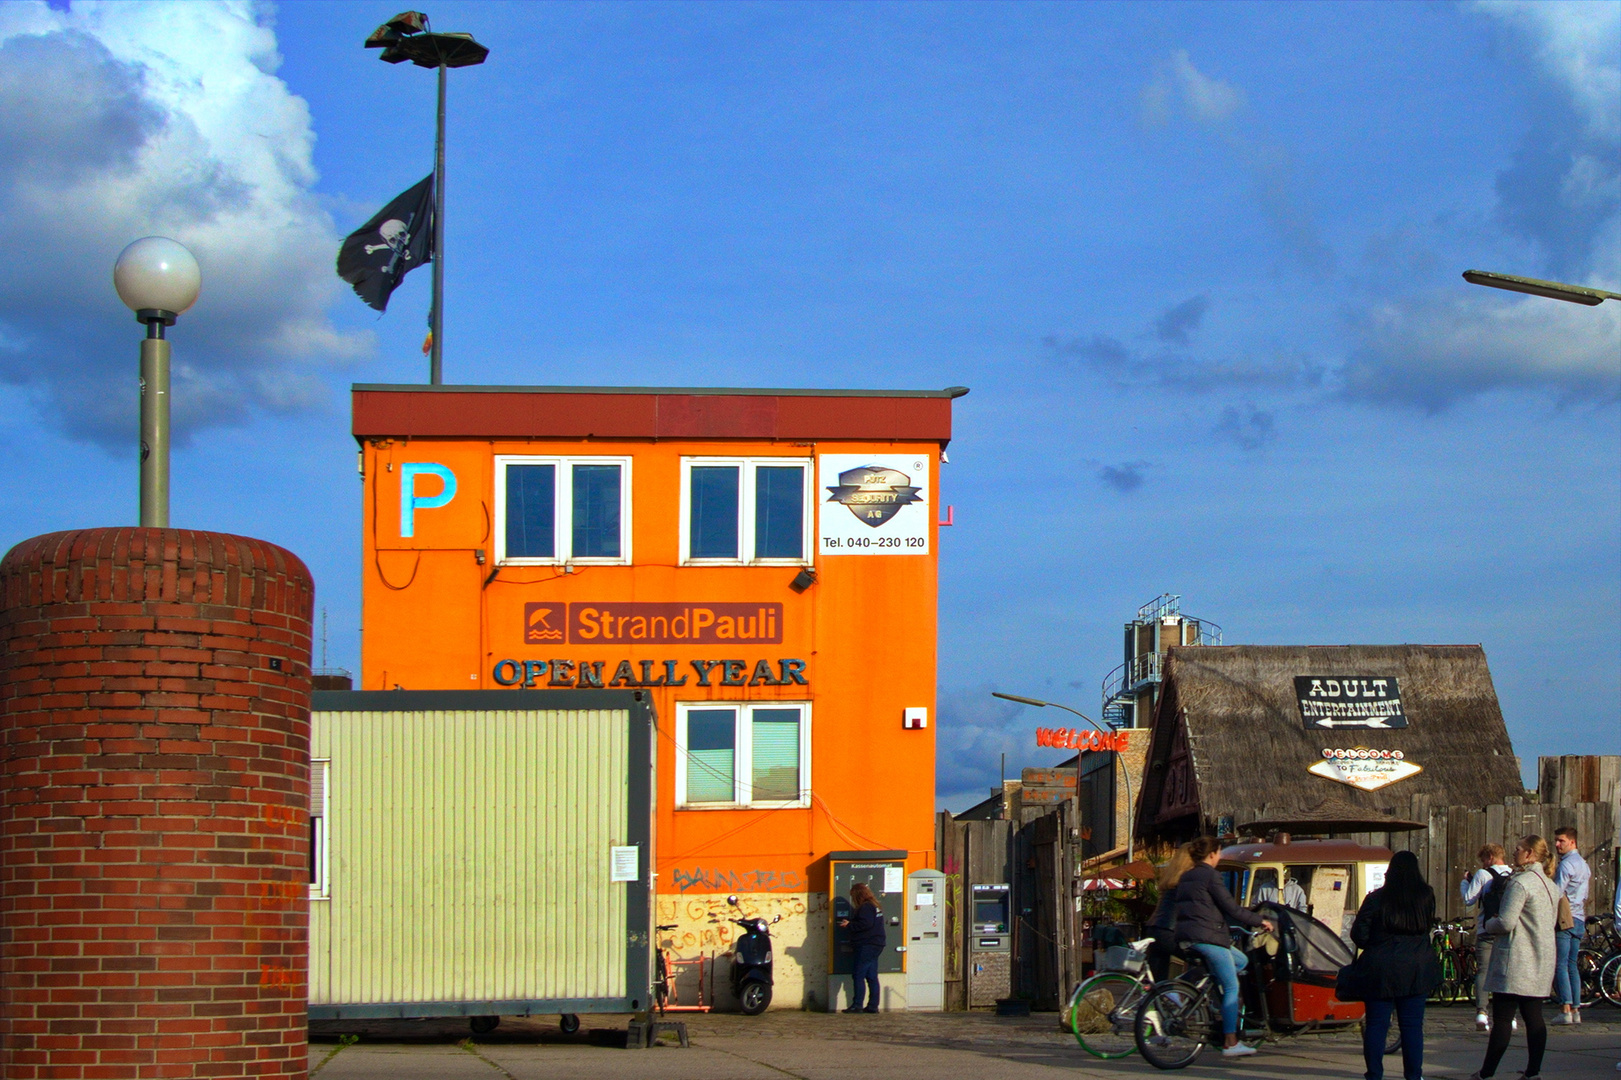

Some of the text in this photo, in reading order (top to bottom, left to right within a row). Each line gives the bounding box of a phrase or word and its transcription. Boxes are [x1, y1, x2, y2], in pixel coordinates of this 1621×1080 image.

[399, 462, 457, 538] P
[851, 493, 899, 503] SECURITY
[823, 537, 844, 548] Tel.
[905, 537, 925, 548] 120
[577, 607, 777, 640] StrandPauli
[492, 658, 810, 688] OPEN ALL YEAR
[1309, 679, 1387, 697] ADULT
[1301, 699, 1402, 717] ENTERTAINMENT
[1036, 727, 1129, 752] WELCOME
[1323, 749, 1402, 759] WELCOME
